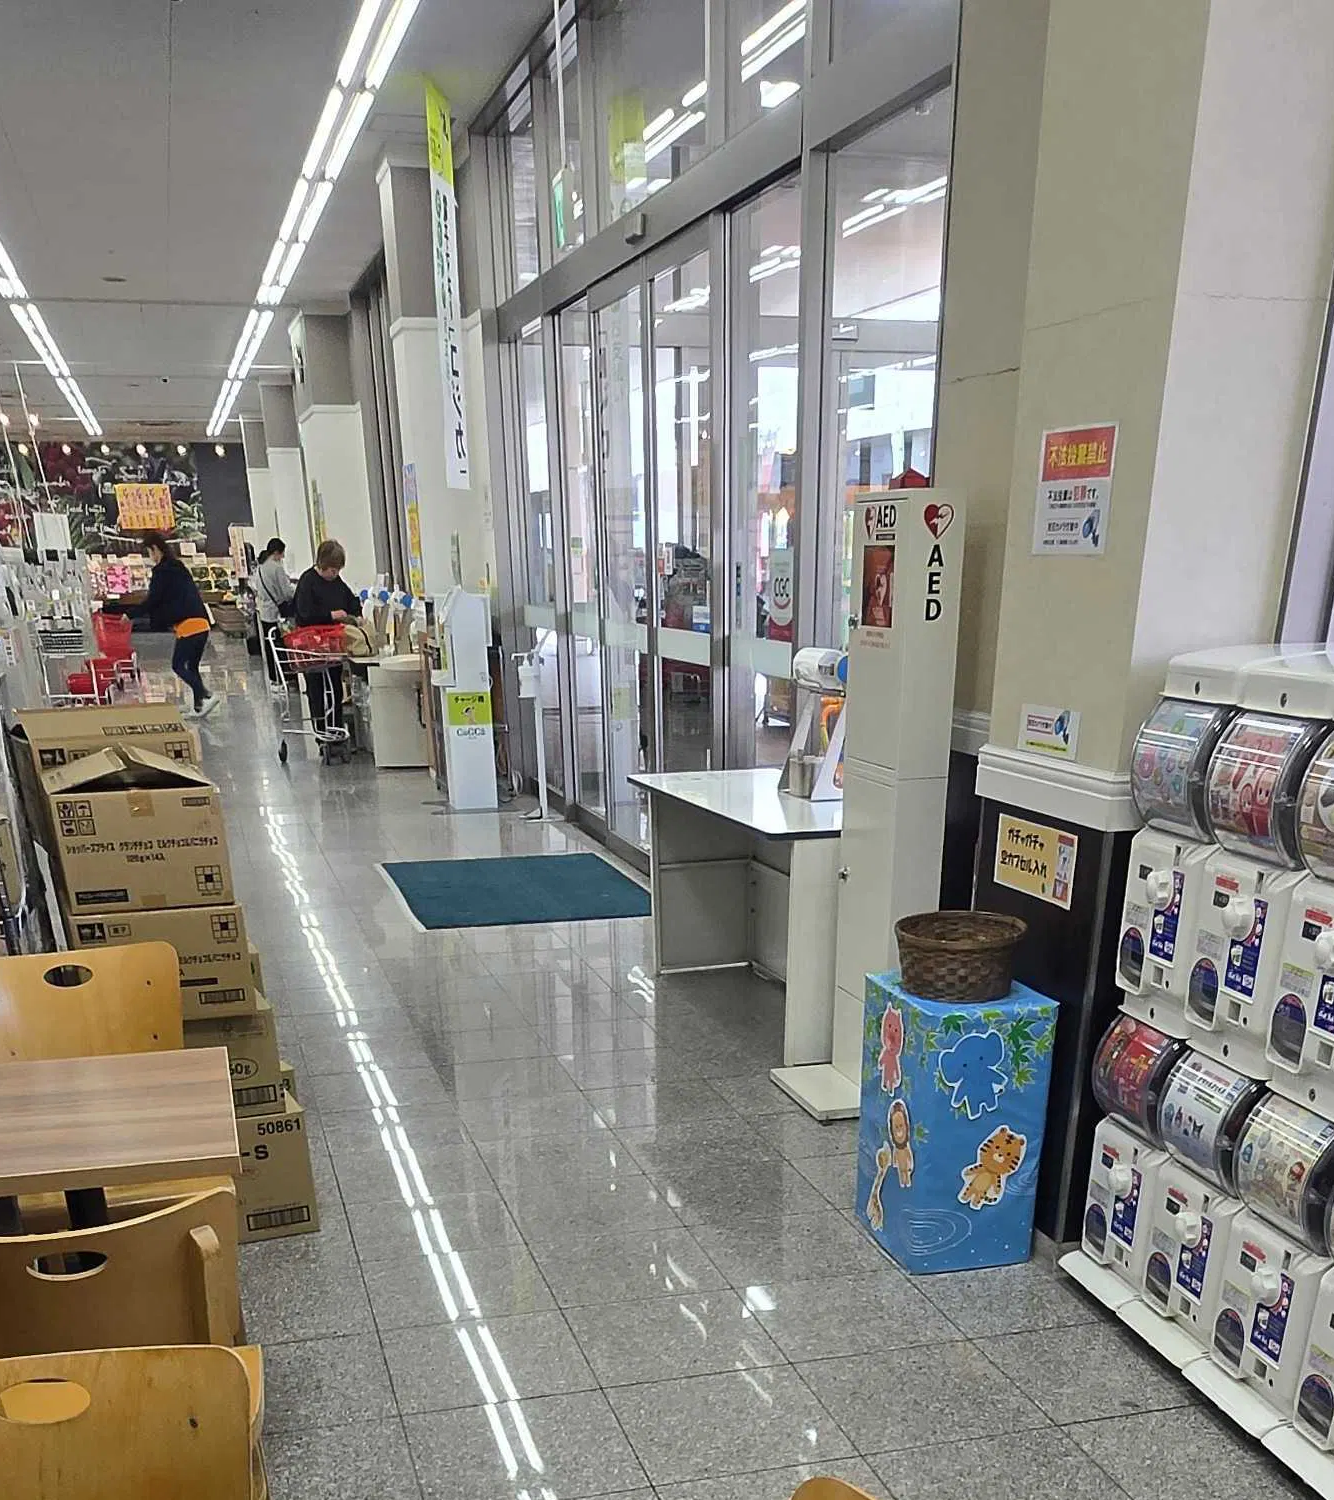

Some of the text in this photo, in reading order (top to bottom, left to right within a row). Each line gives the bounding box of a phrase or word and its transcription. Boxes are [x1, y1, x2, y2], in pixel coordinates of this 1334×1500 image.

[876, 504, 897, 528] AED
[773, 577, 790, 598] CGC
[924, 543, 944, 621] AED
[1007, 826, 1045, 852] ガチャガチャ
[1000, 850, 1048, 879] 空カプセル入れ
[257, 1118, 301, 1136] 50861
